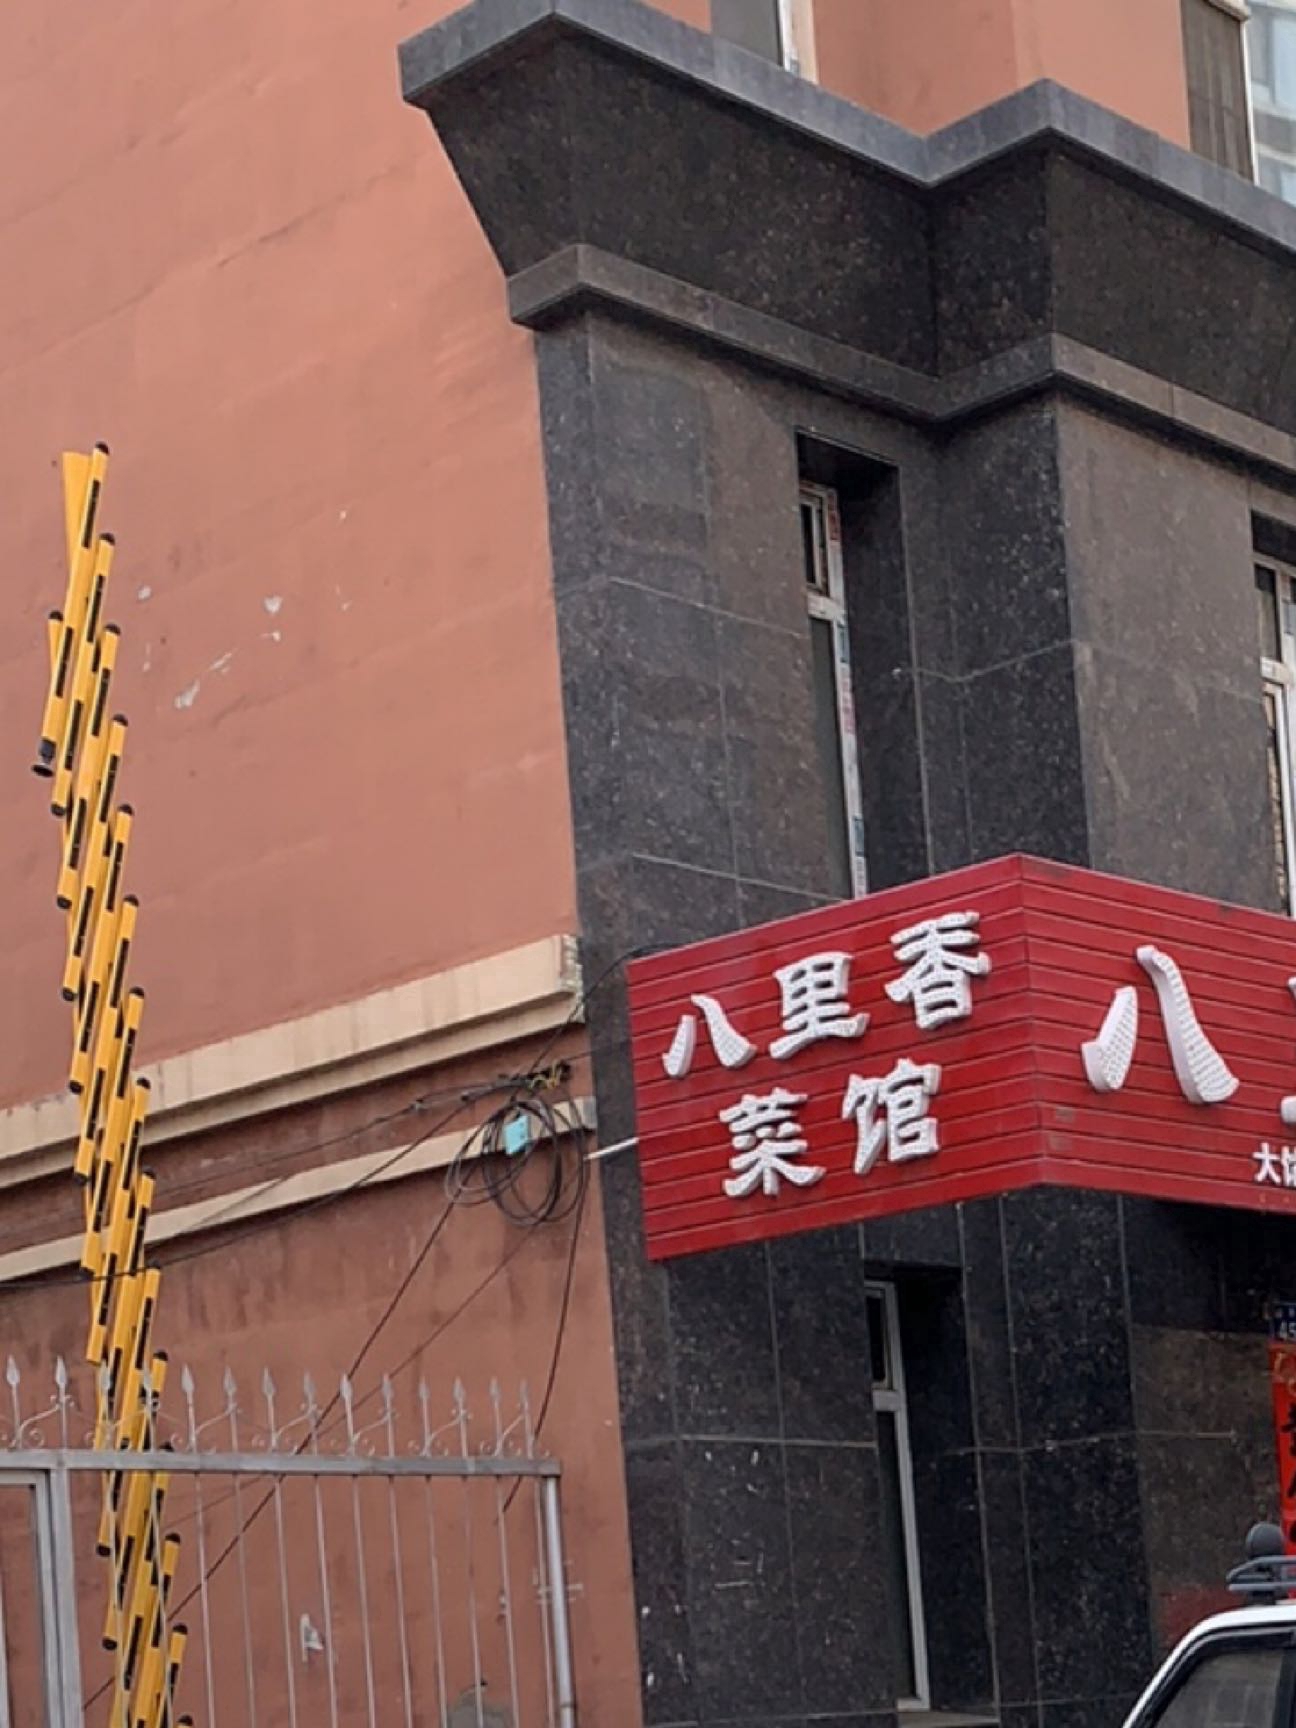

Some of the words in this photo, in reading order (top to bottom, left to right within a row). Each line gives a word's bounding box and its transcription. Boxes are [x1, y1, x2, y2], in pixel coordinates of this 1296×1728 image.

[662, 910, 992, 1078] 八里香
[719, 1058, 942, 1198] 菜馆
